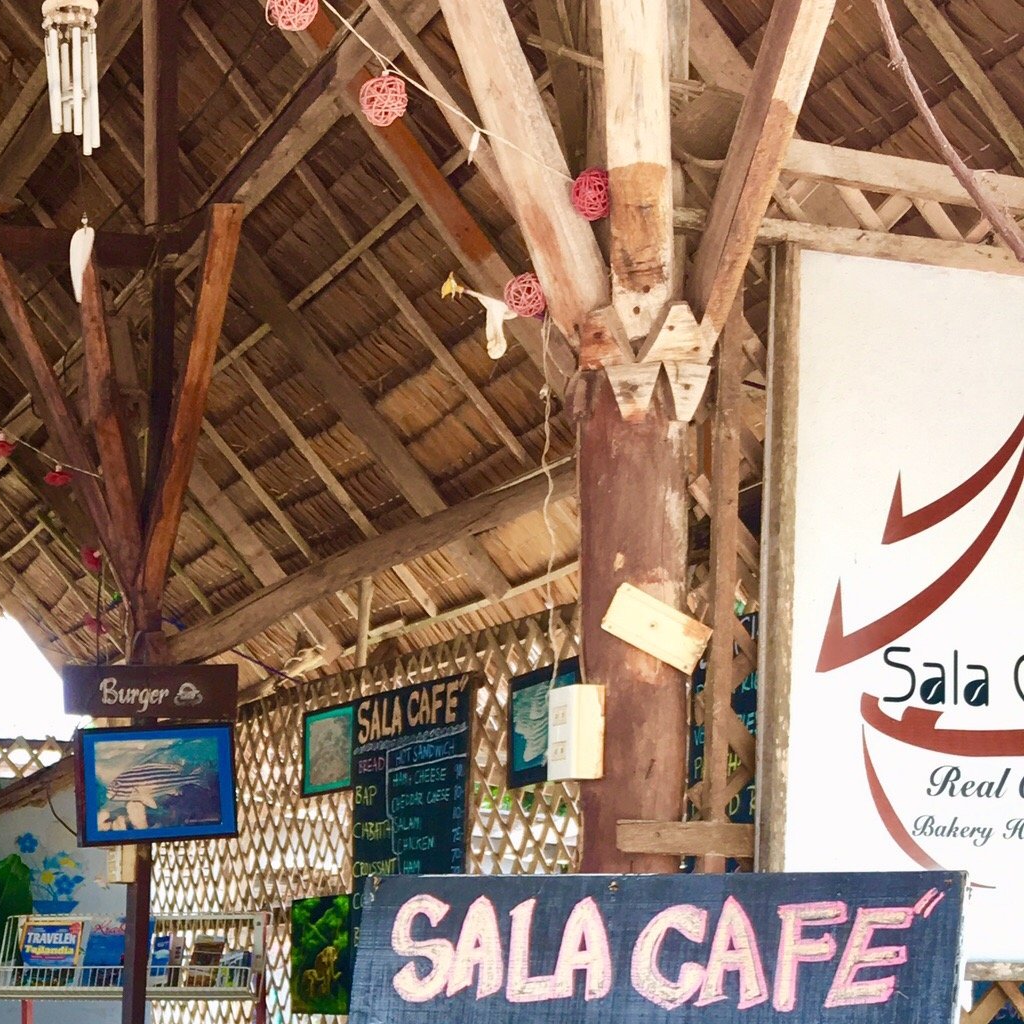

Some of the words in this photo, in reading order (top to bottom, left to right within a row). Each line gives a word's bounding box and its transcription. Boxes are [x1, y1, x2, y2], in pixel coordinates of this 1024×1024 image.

[882, 646, 989, 707] Sala
[99, 677, 170, 713] Burger
[357, 696, 403, 744] SALA
[358, 757, 385, 774] BREAD
[927, 765, 1012, 798] Real
[355, 785, 377, 806] BAP
[912, 815, 995, 847] Bakery
[392, 894, 610, 1003] SALA
